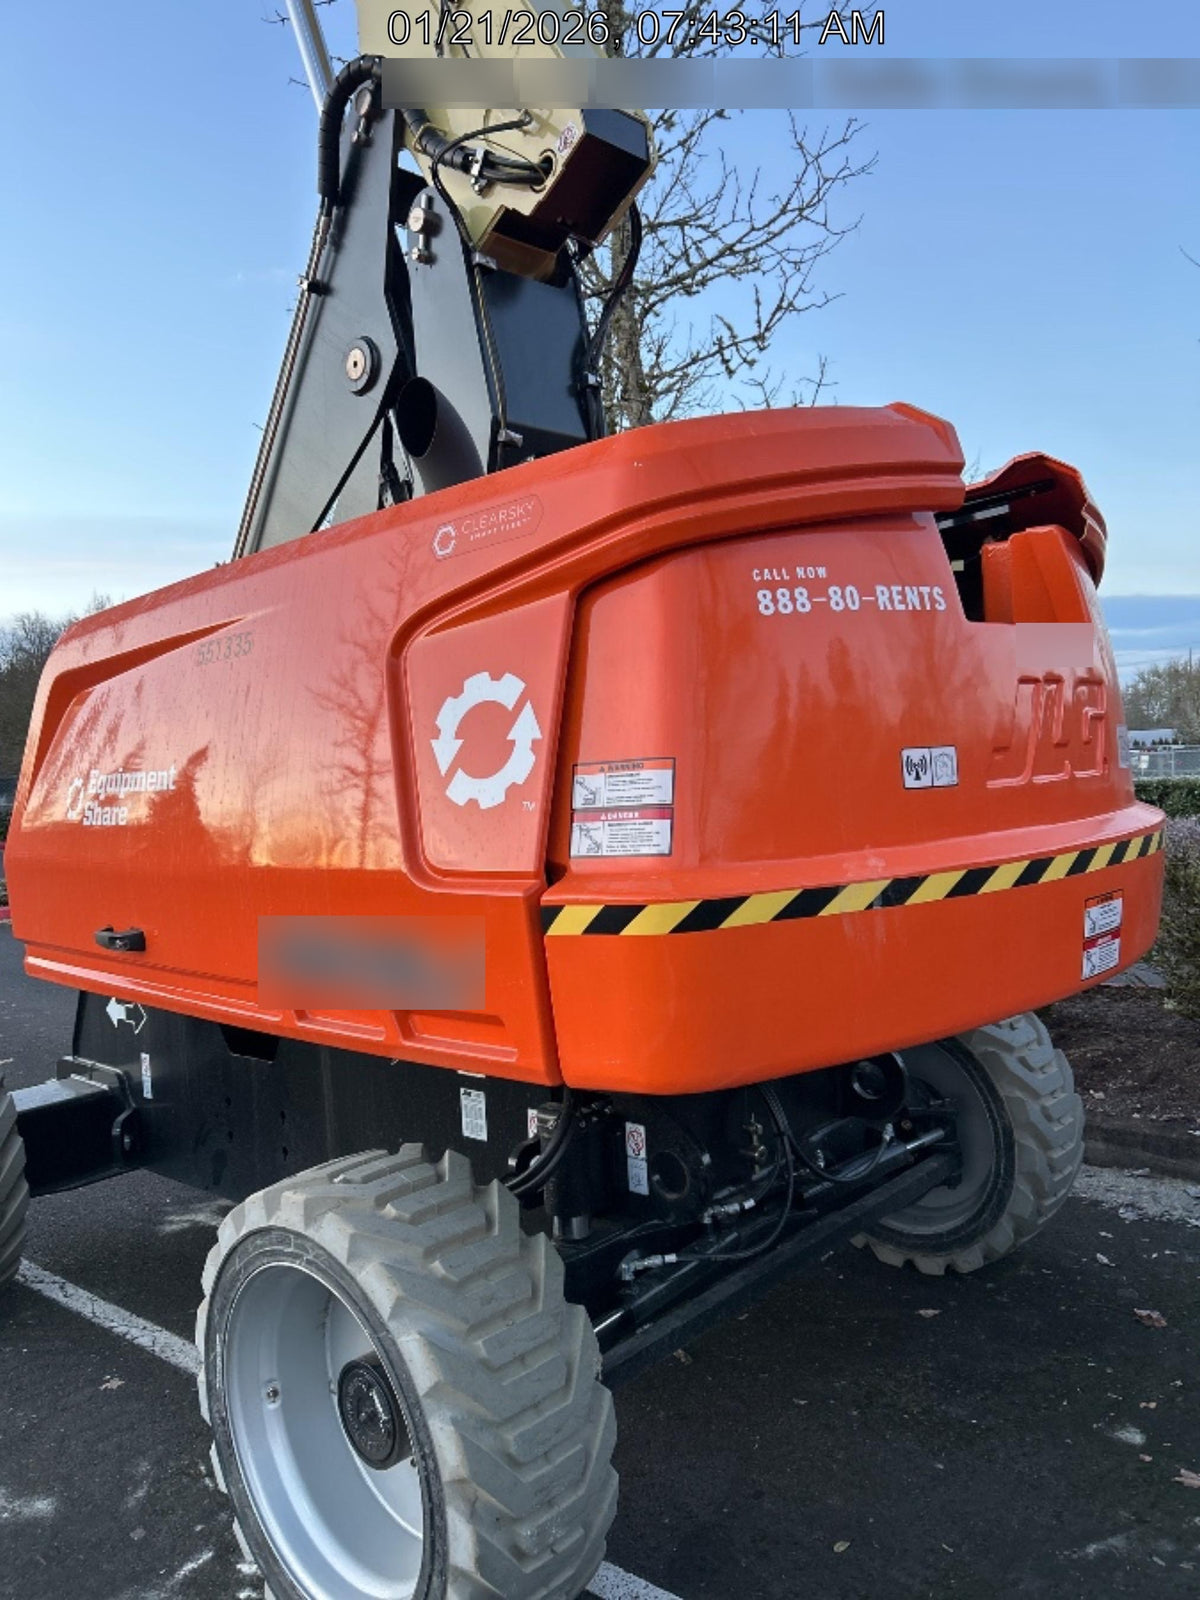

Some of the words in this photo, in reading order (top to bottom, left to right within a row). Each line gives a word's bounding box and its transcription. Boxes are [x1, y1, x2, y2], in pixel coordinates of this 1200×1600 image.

[461, 500, 535, 535] CLEARSKY
[753, 567, 790, 582] CALL
[796, 566, 827, 579] NOW
[756, 584, 947, 616] 888-80-RENTS
[87, 764, 177, 801] Equipment
[83, 801, 129, 826] Share
